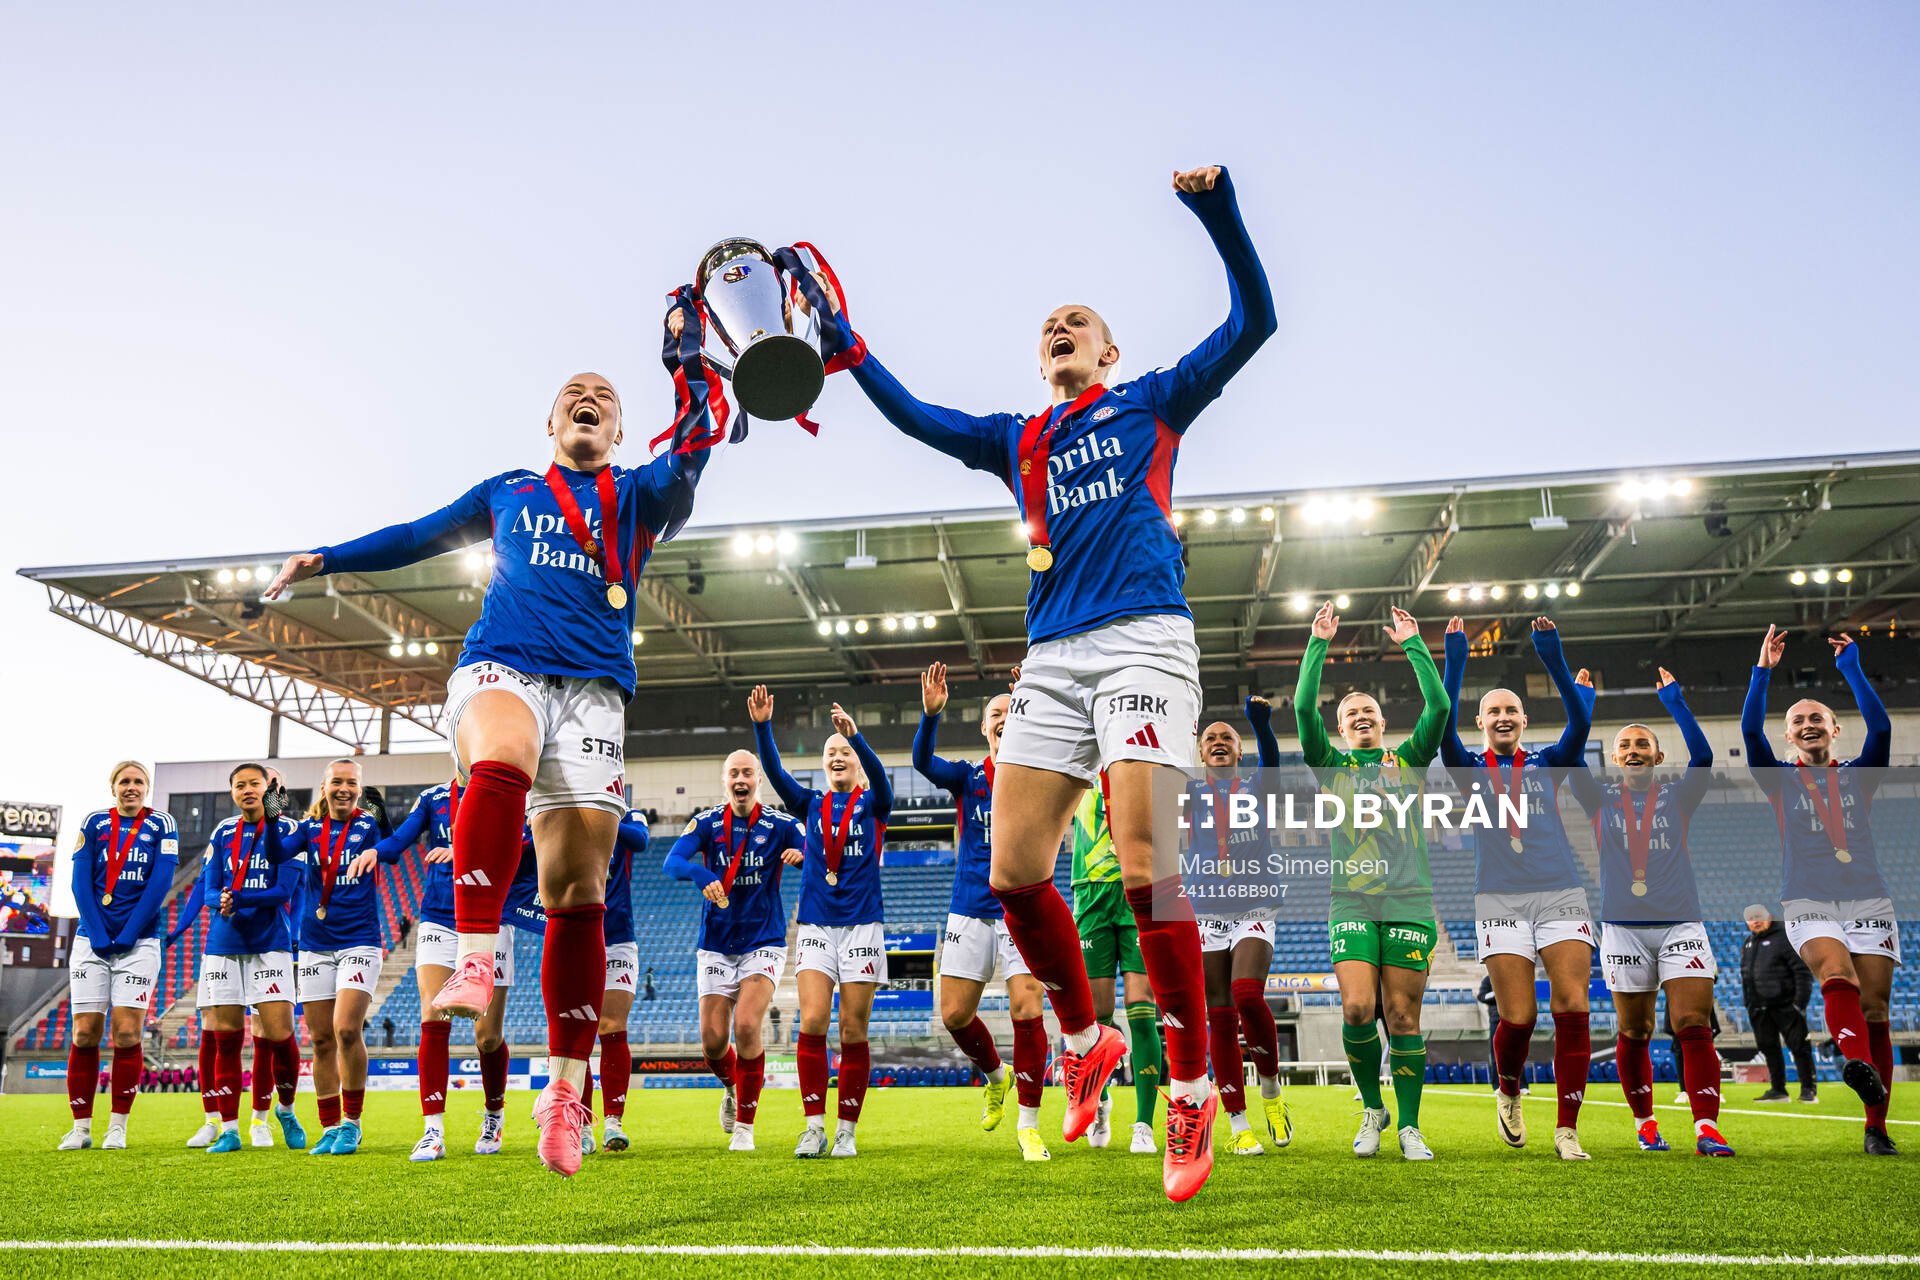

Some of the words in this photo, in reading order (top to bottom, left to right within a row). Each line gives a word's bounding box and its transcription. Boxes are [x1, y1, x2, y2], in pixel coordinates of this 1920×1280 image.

[1047, 431, 1125, 488] prila
[1046, 467, 1126, 516] Bank
[511, 504, 603, 539] Aprla
[478, 673, 500, 686] 10
[119, 867, 145, 882] ank
[1333, 938, 1347, 954] 32
[640, 1061, 679, 1070] ANTON
[680, 1061, 705, 1070] SPOR
